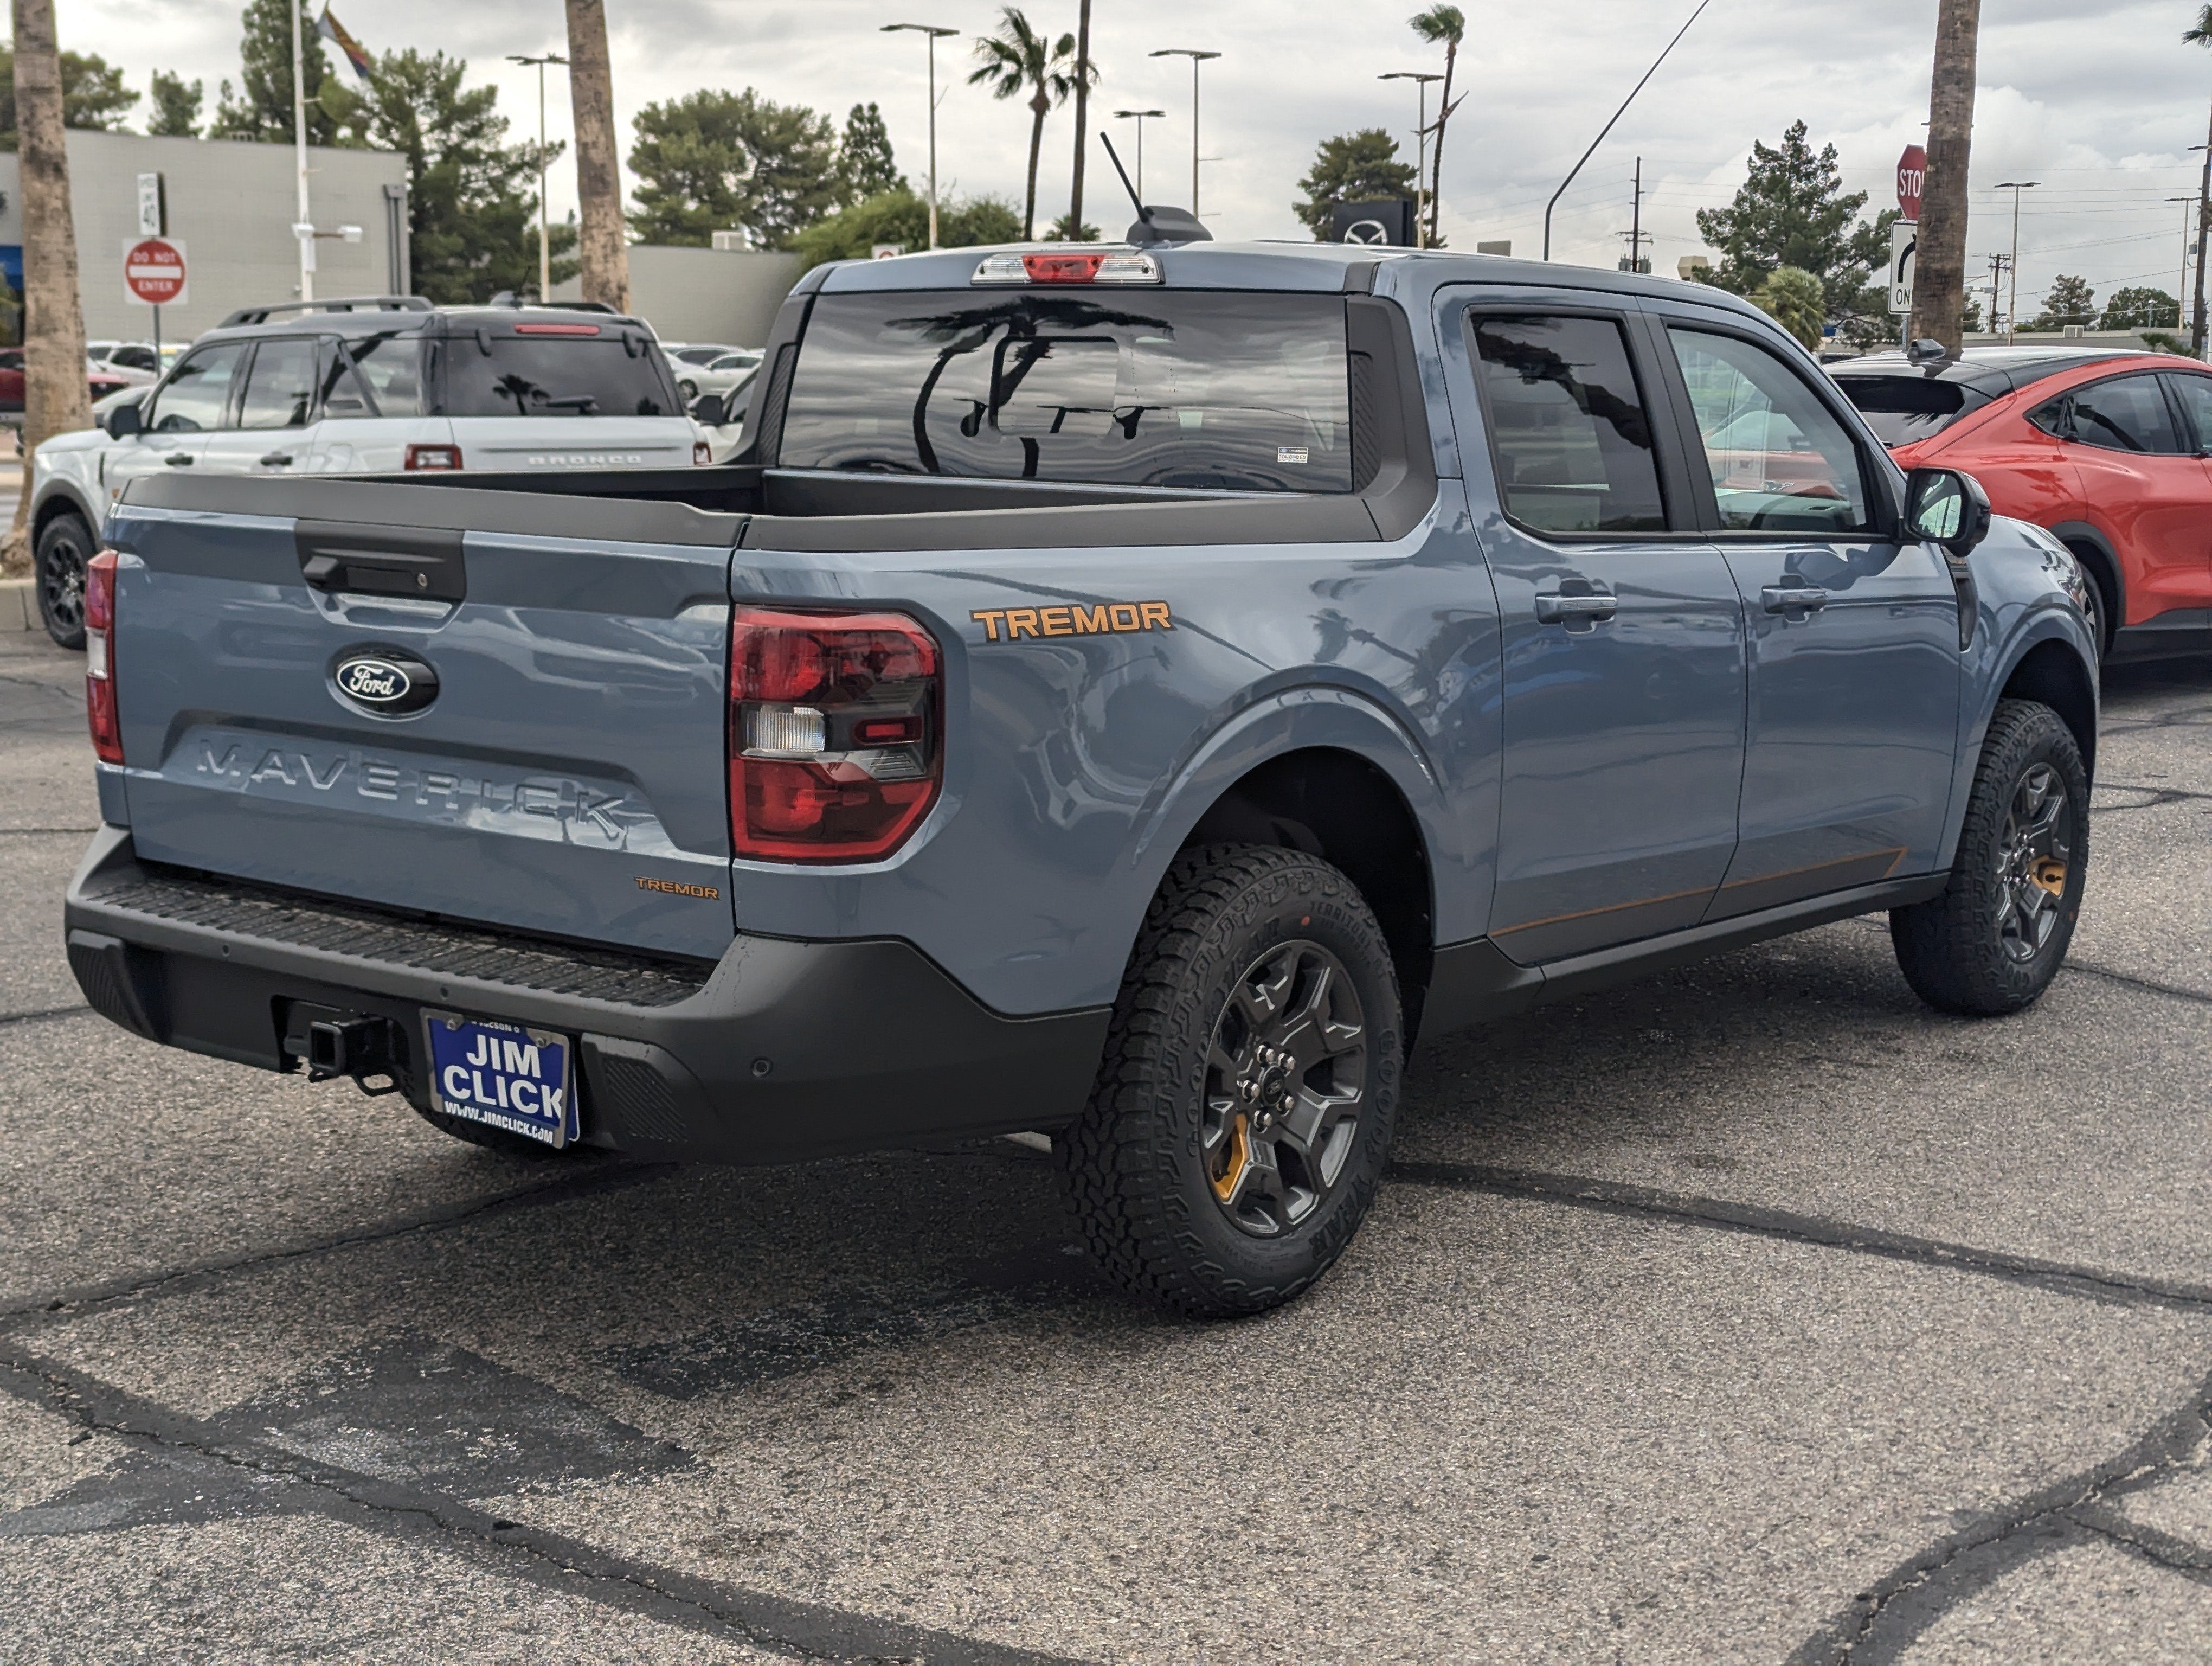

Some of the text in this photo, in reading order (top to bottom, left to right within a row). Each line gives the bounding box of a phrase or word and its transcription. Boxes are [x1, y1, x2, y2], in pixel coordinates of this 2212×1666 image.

[133, 252, 176, 263] DO NOT
[138, 280, 174, 292] ENTER
[529, 456, 641, 465] BRONCO
[969, 600, 1175, 642] TREMOR
[349, 659, 396, 695] Ford
[197, 739, 626, 838] MAVERICK
[634, 877, 719, 900] TREMOR
[466, 1034, 541, 1078] JIM
[443, 1065, 563, 1118] CLICK
[445, 1101, 554, 1144] WWW.JIMCLICK.COM
